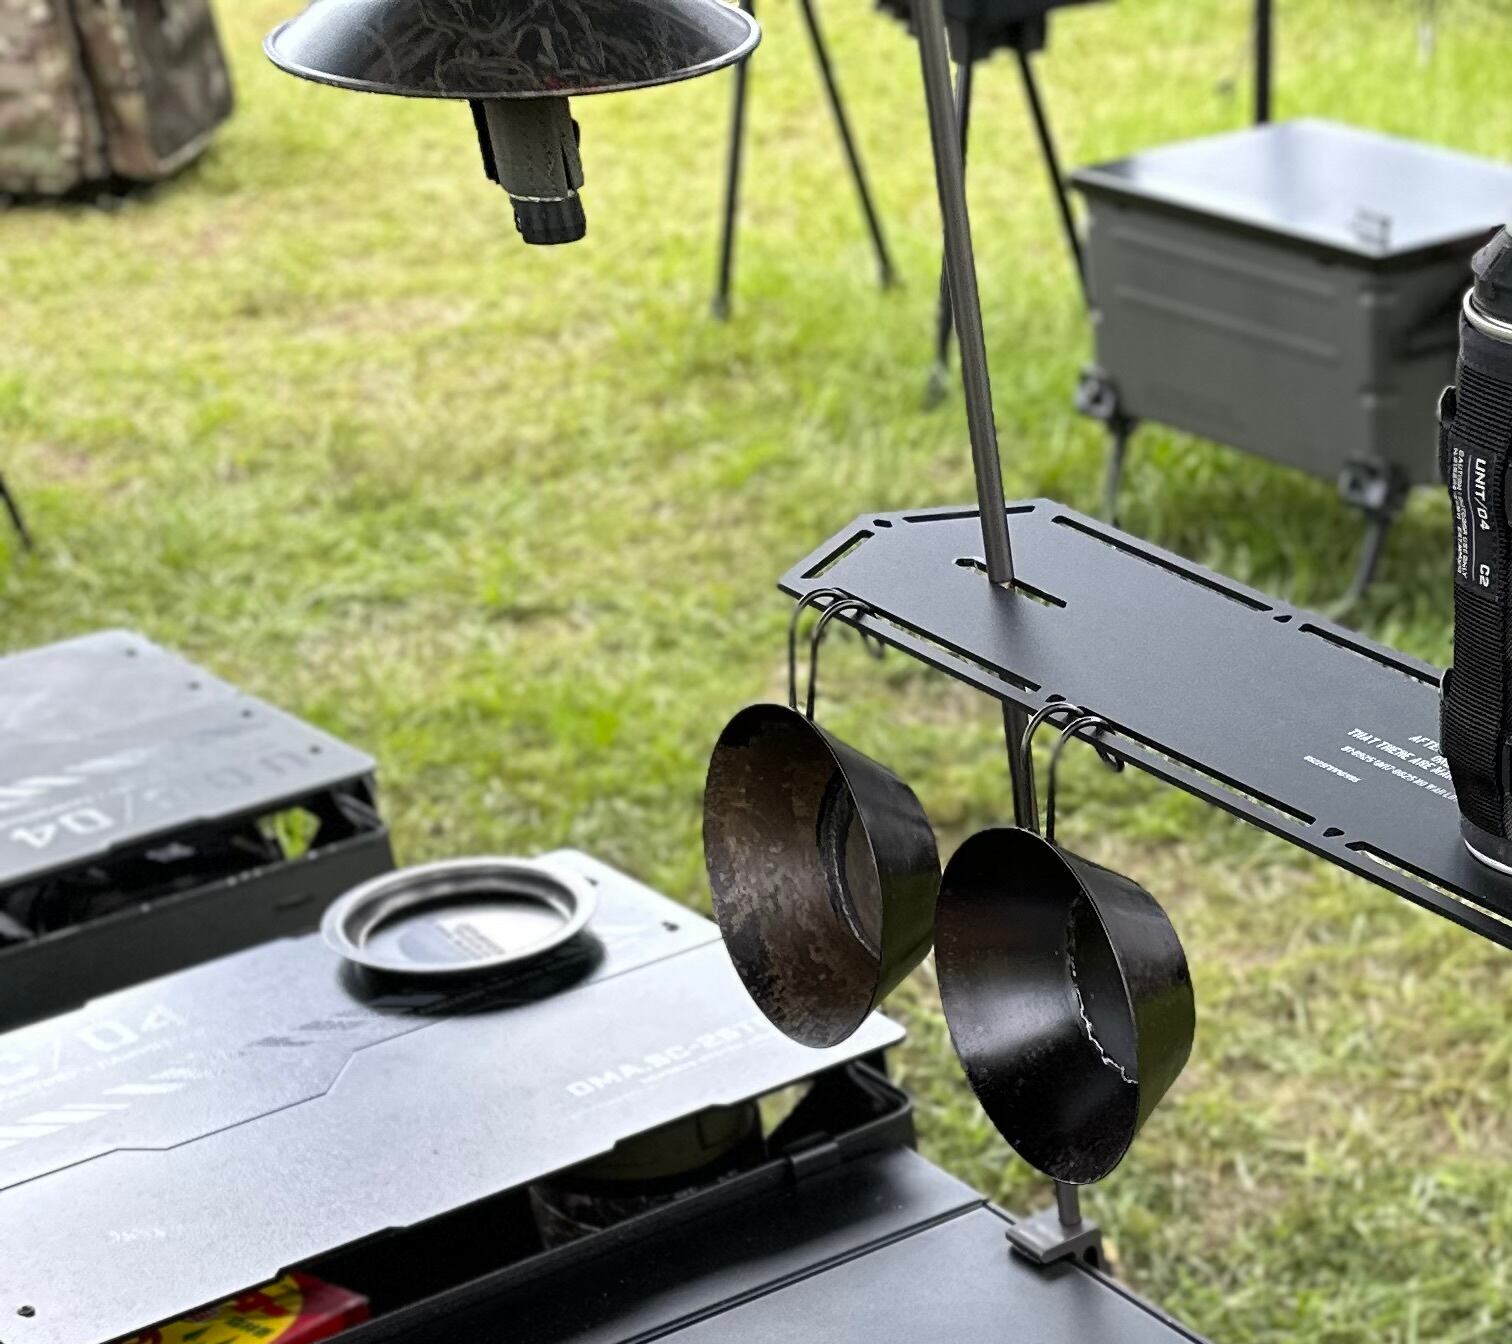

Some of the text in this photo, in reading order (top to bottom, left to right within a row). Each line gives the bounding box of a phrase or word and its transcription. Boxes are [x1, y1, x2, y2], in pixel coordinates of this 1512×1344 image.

[1478, 563, 1490, 587] C2
[1347, 728, 1380, 743] THAT
[1376, 740, 1415, 760] THERE
[1408, 756, 1435, 769] ARE
